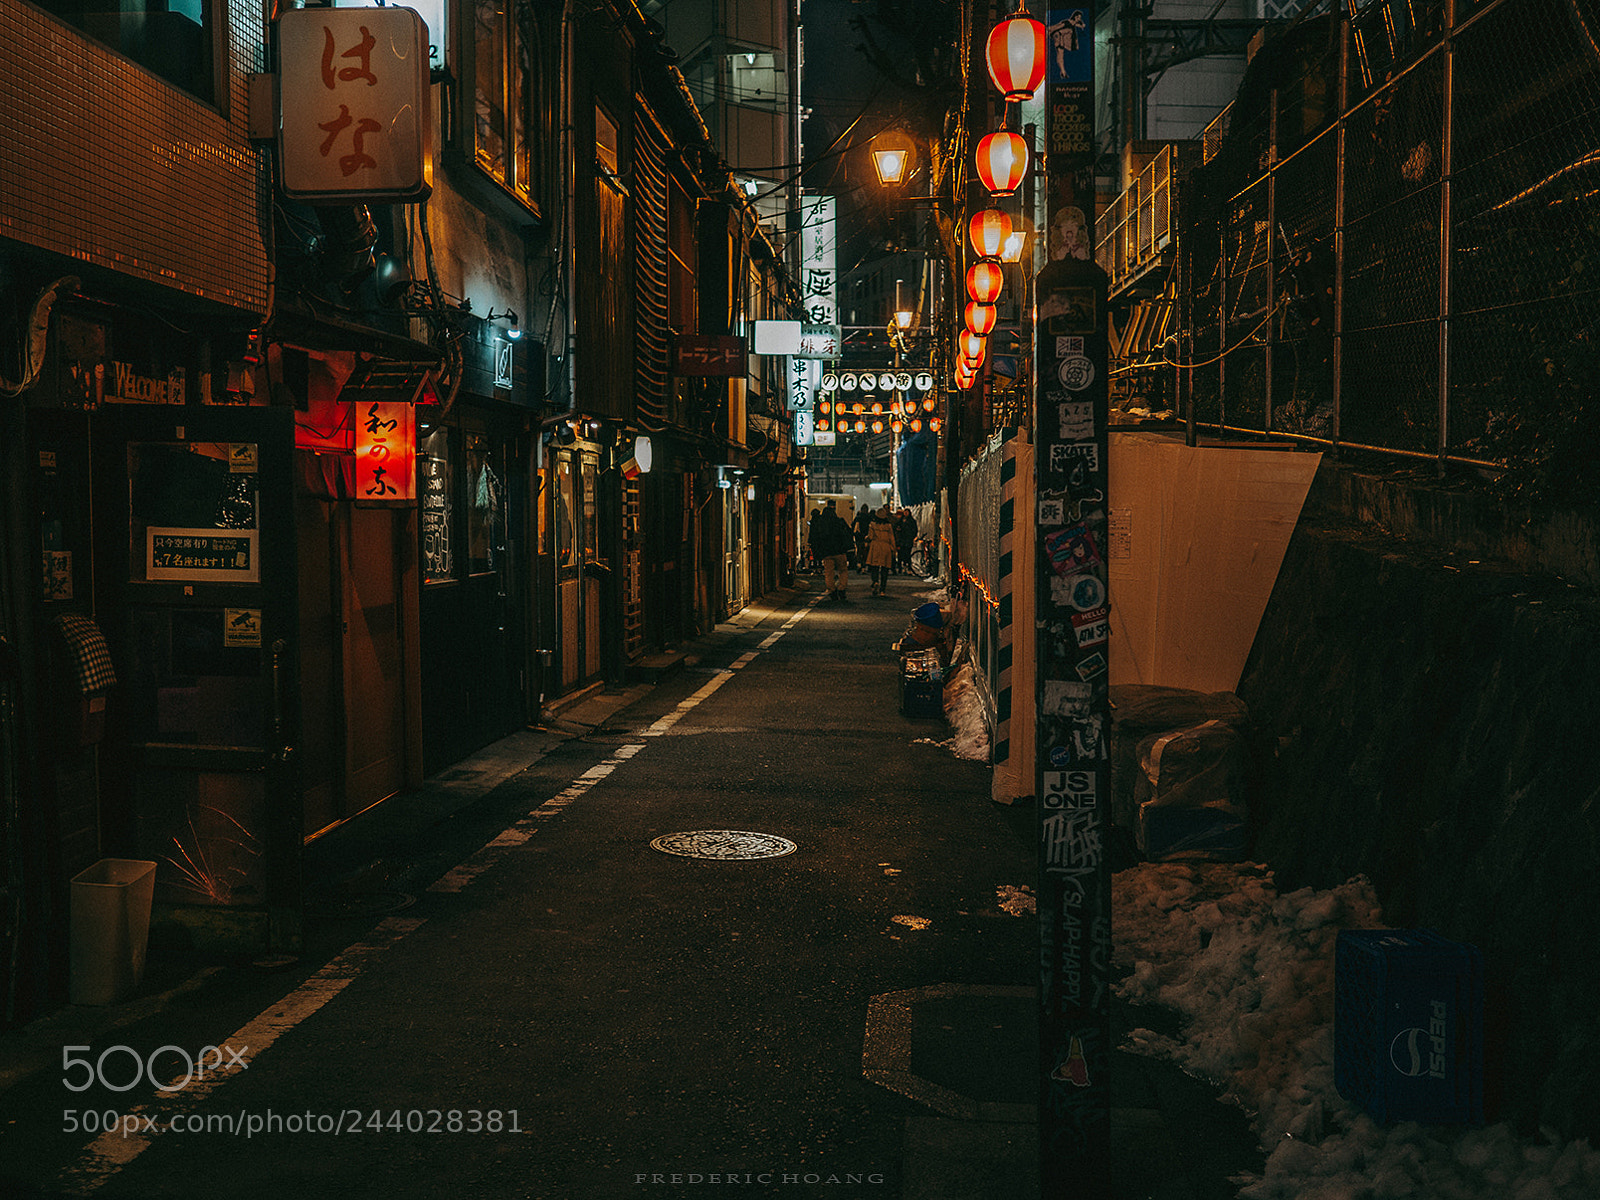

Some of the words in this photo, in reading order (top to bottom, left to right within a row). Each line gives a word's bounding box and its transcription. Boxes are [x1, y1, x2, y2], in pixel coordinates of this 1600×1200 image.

[317, 26, 383, 177] はな
[1053, 114, 1085, 123] TROOP
[1052, 132, 1084, 142] GOOD
[1053, 142, 1091, 152] THINGS
[1053, 446, 1094, 458] SKATE
[1080, 607, 1107, 621] HELLO
[1050, 772, 1089, 792] JS
[1044, 793, 1095, 808] ONE
[1430, 1000, 1447, 1080] PEPSI
